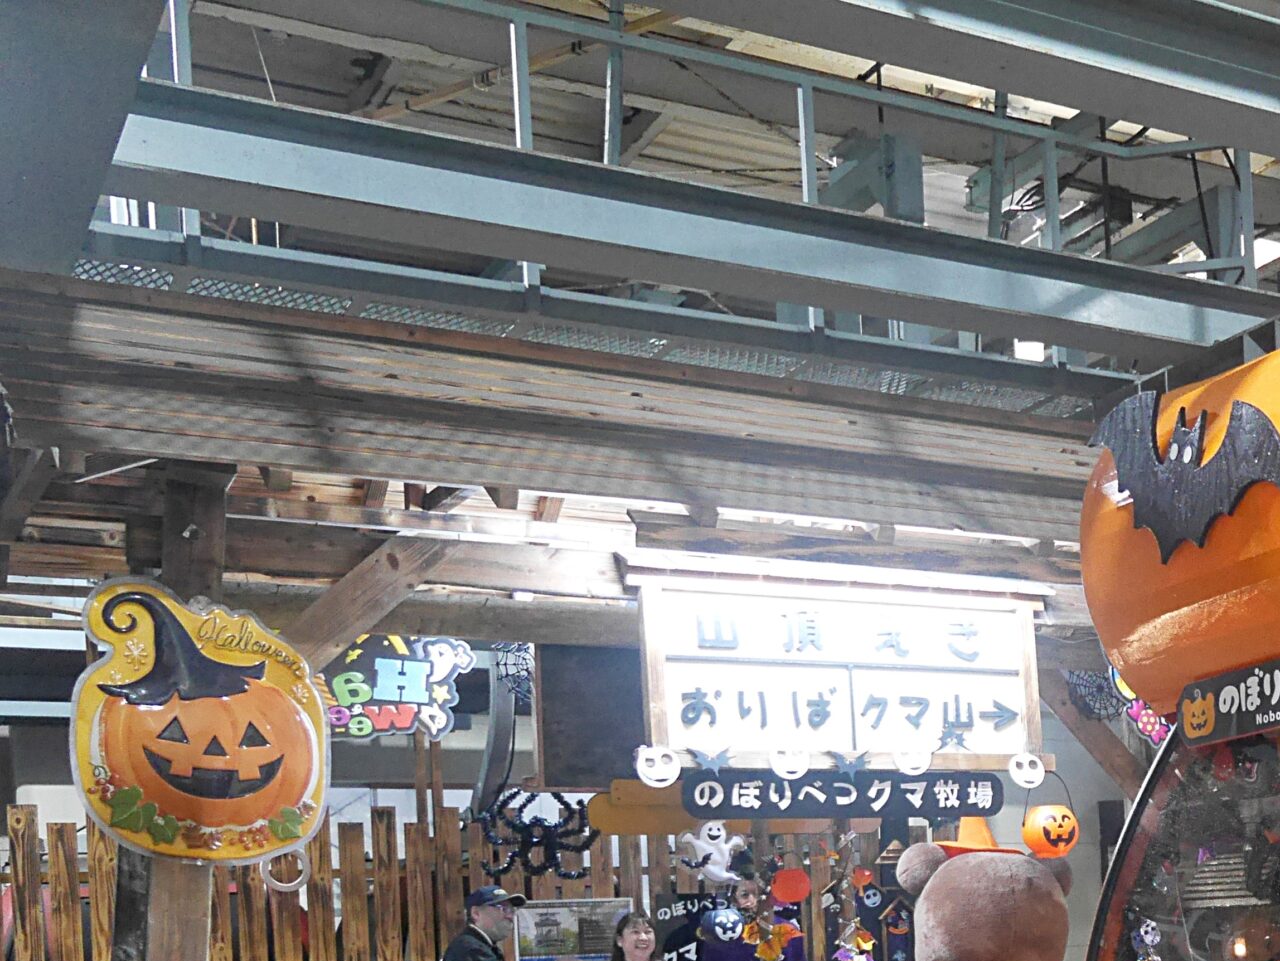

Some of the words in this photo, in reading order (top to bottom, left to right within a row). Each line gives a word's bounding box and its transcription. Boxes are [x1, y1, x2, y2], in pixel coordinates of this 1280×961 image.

[197, 616, 302, 679] Halloween
[697, 610, 981, 662] 山頂えき
[681, 686, 838, 730] おりば
[860, 694, 974, 731] クマ山
[693, 779, 994, 813] のぼりべつクマ牧場
